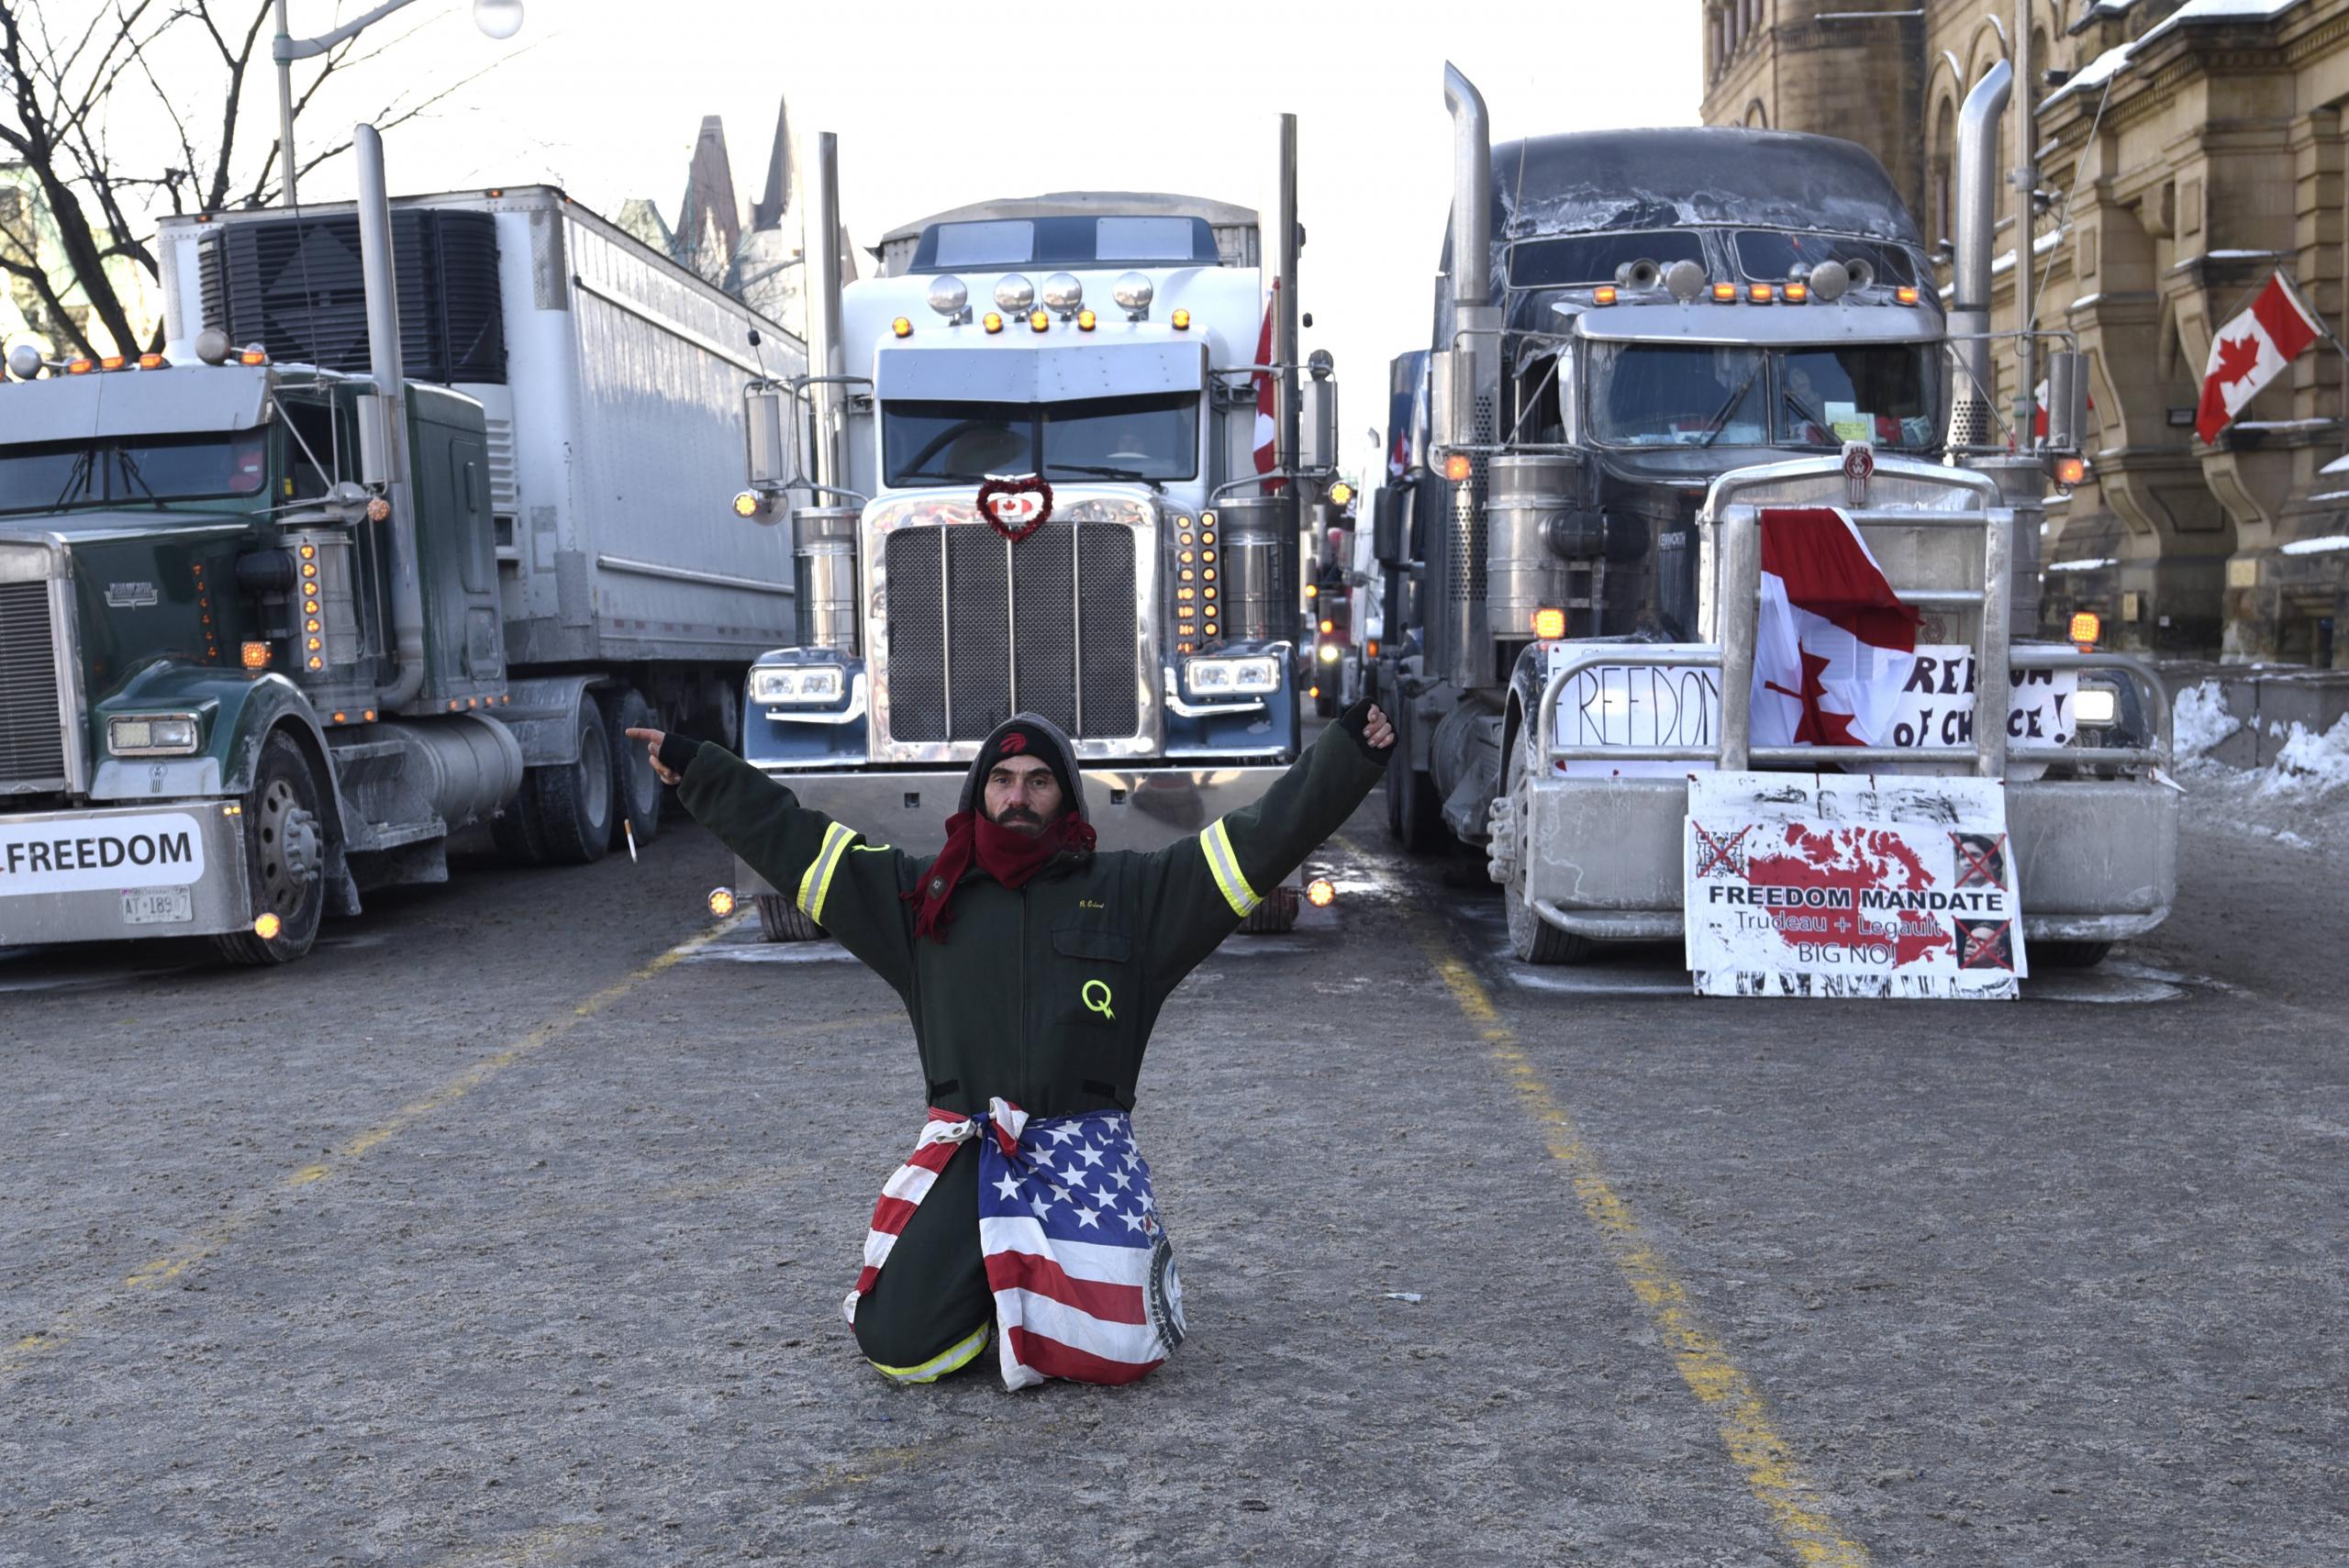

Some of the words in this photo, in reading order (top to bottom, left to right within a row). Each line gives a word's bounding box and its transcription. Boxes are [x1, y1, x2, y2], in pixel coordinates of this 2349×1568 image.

[1893, 706, 1933, 748] OF
[6, 831, 193, 873] FREEDOM
[1708, 885, 1852, 909] FREEDOM
[1861, 888, 2004, 912] MANDATE
[1734, 910, 1827, 931] Trudeau
[1858, 917, 1942, 940] Legault
[1798, 942, 1841, 963] BIG
[1849, 943, 1896, 965] NO!
[1082, 979, 1116, 1020] Q
